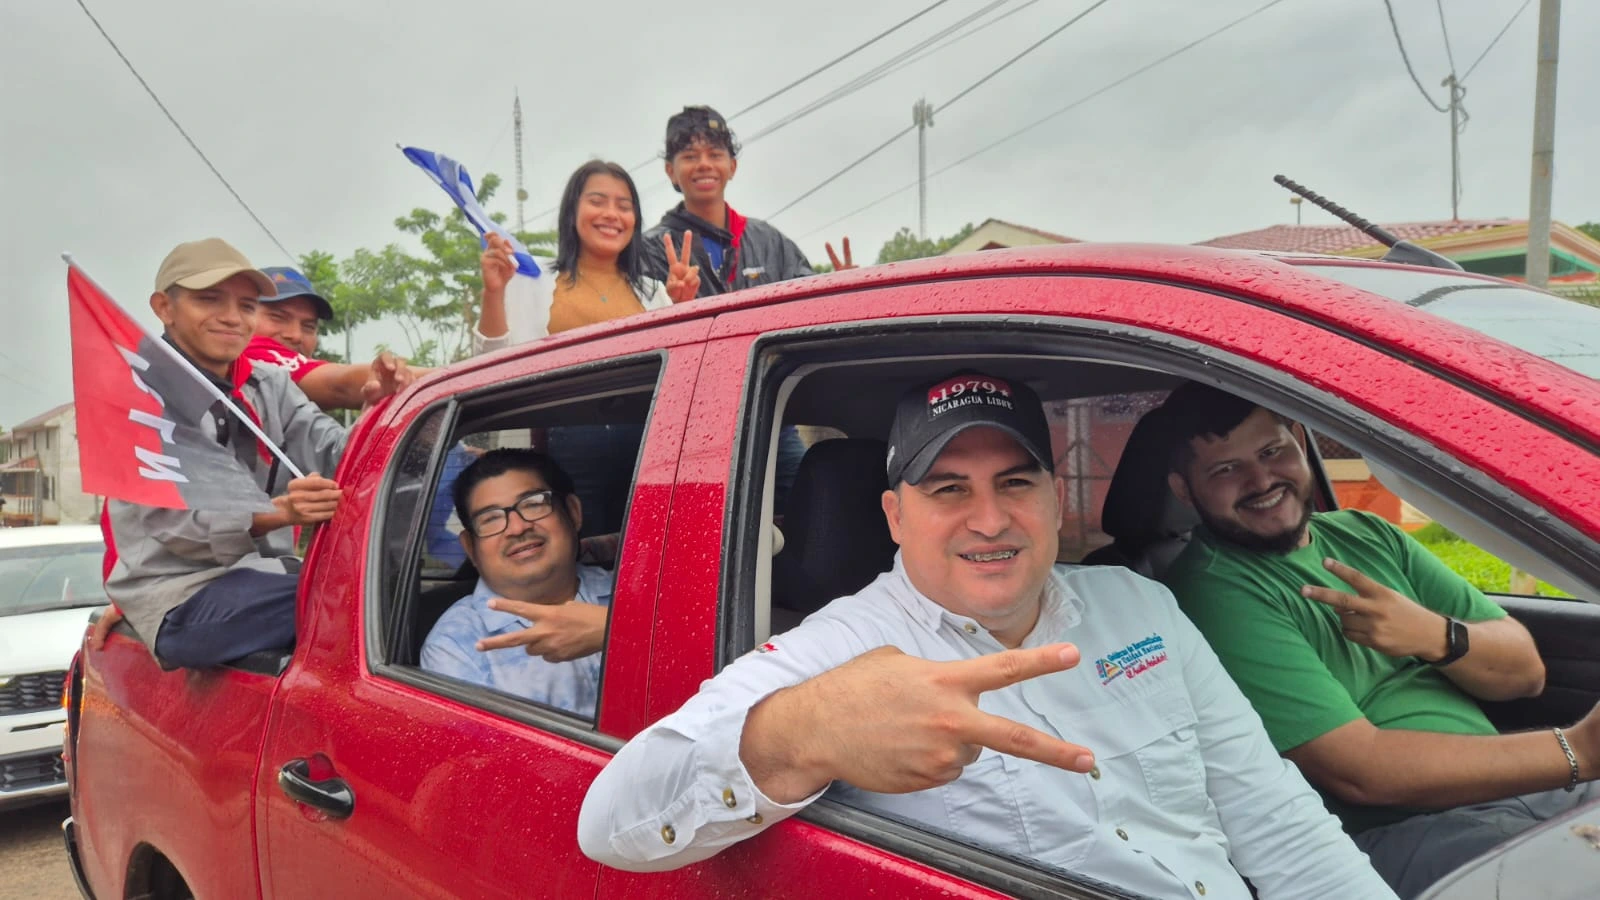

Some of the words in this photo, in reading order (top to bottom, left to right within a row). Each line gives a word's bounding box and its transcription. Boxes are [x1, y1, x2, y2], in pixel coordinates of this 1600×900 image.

[939, 381, 997, 402] 1979
[932, 395, 983, 417] NICARAGUA
[986, 396, 1014, 410] LIBRE
